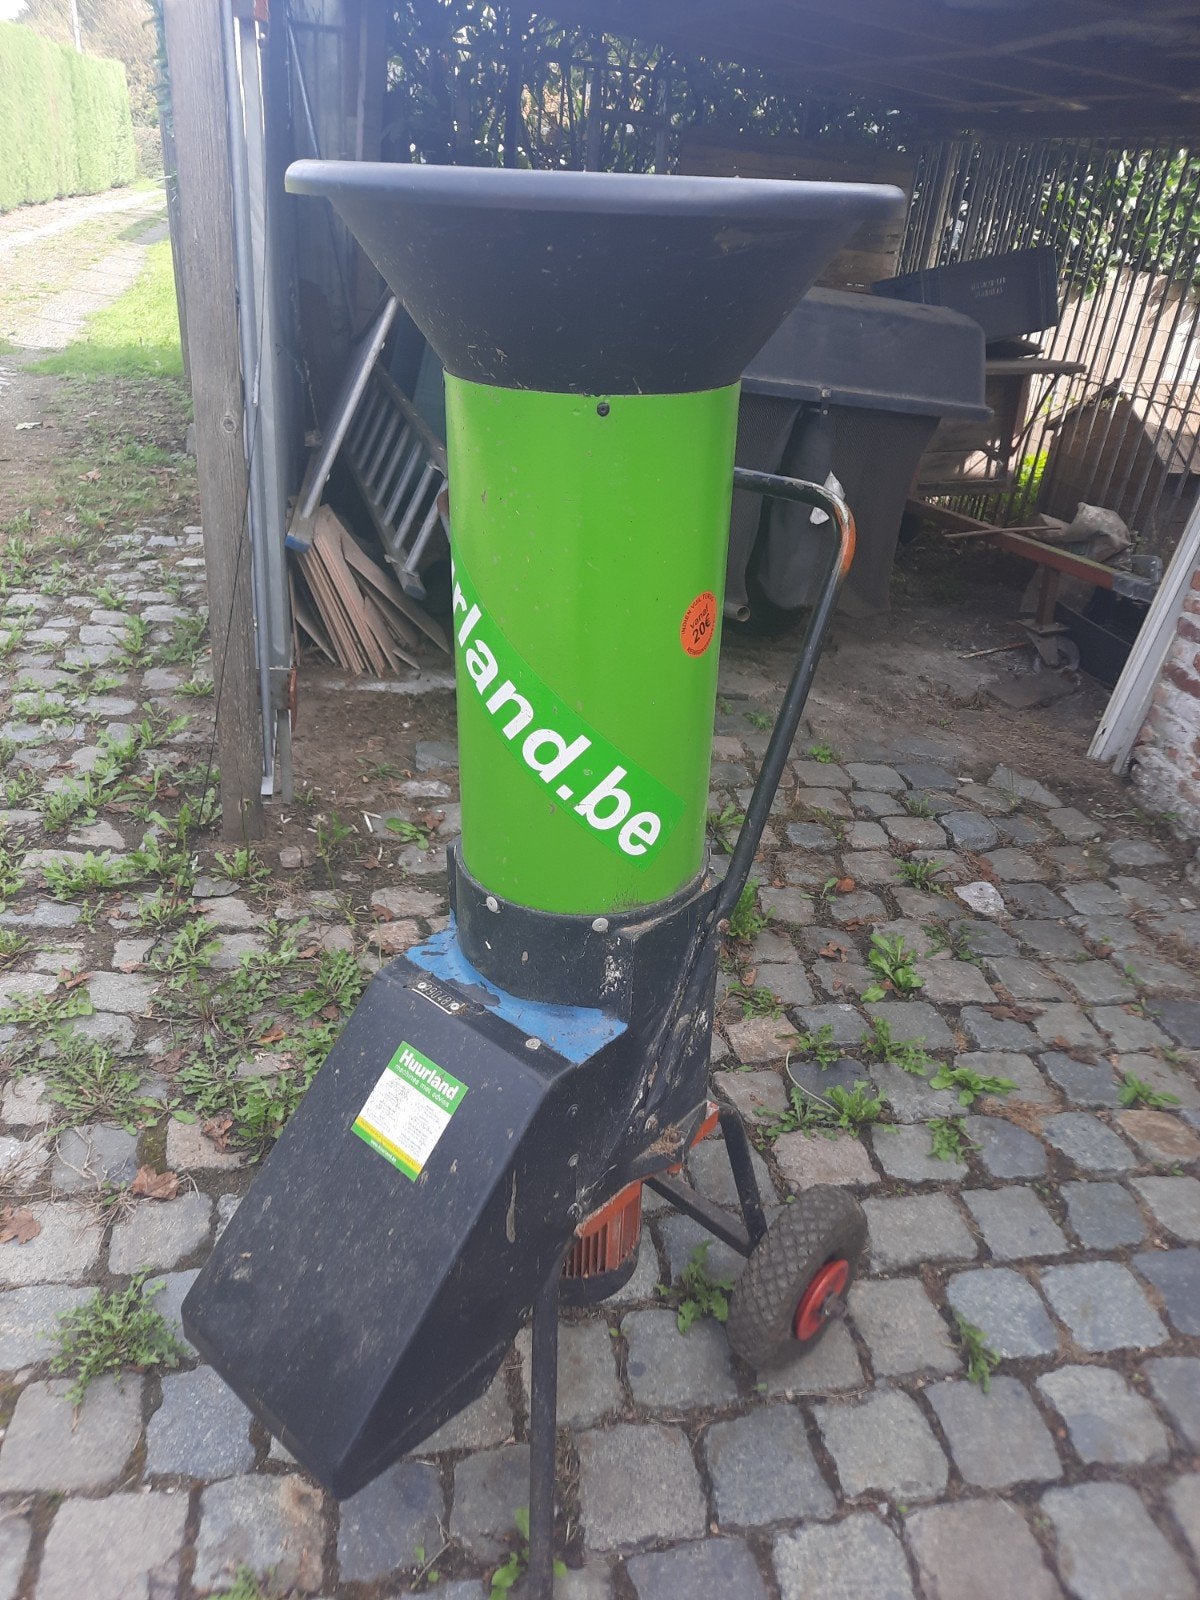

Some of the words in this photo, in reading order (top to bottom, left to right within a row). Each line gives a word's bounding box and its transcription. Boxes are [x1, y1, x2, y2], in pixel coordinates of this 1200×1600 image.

[692, 613, 711, 644] 20€
[451, 560, 662, 856] rland.be
[399, 1049, 460, 1101] Huurland
[420, 1082, 433, 1095] met
